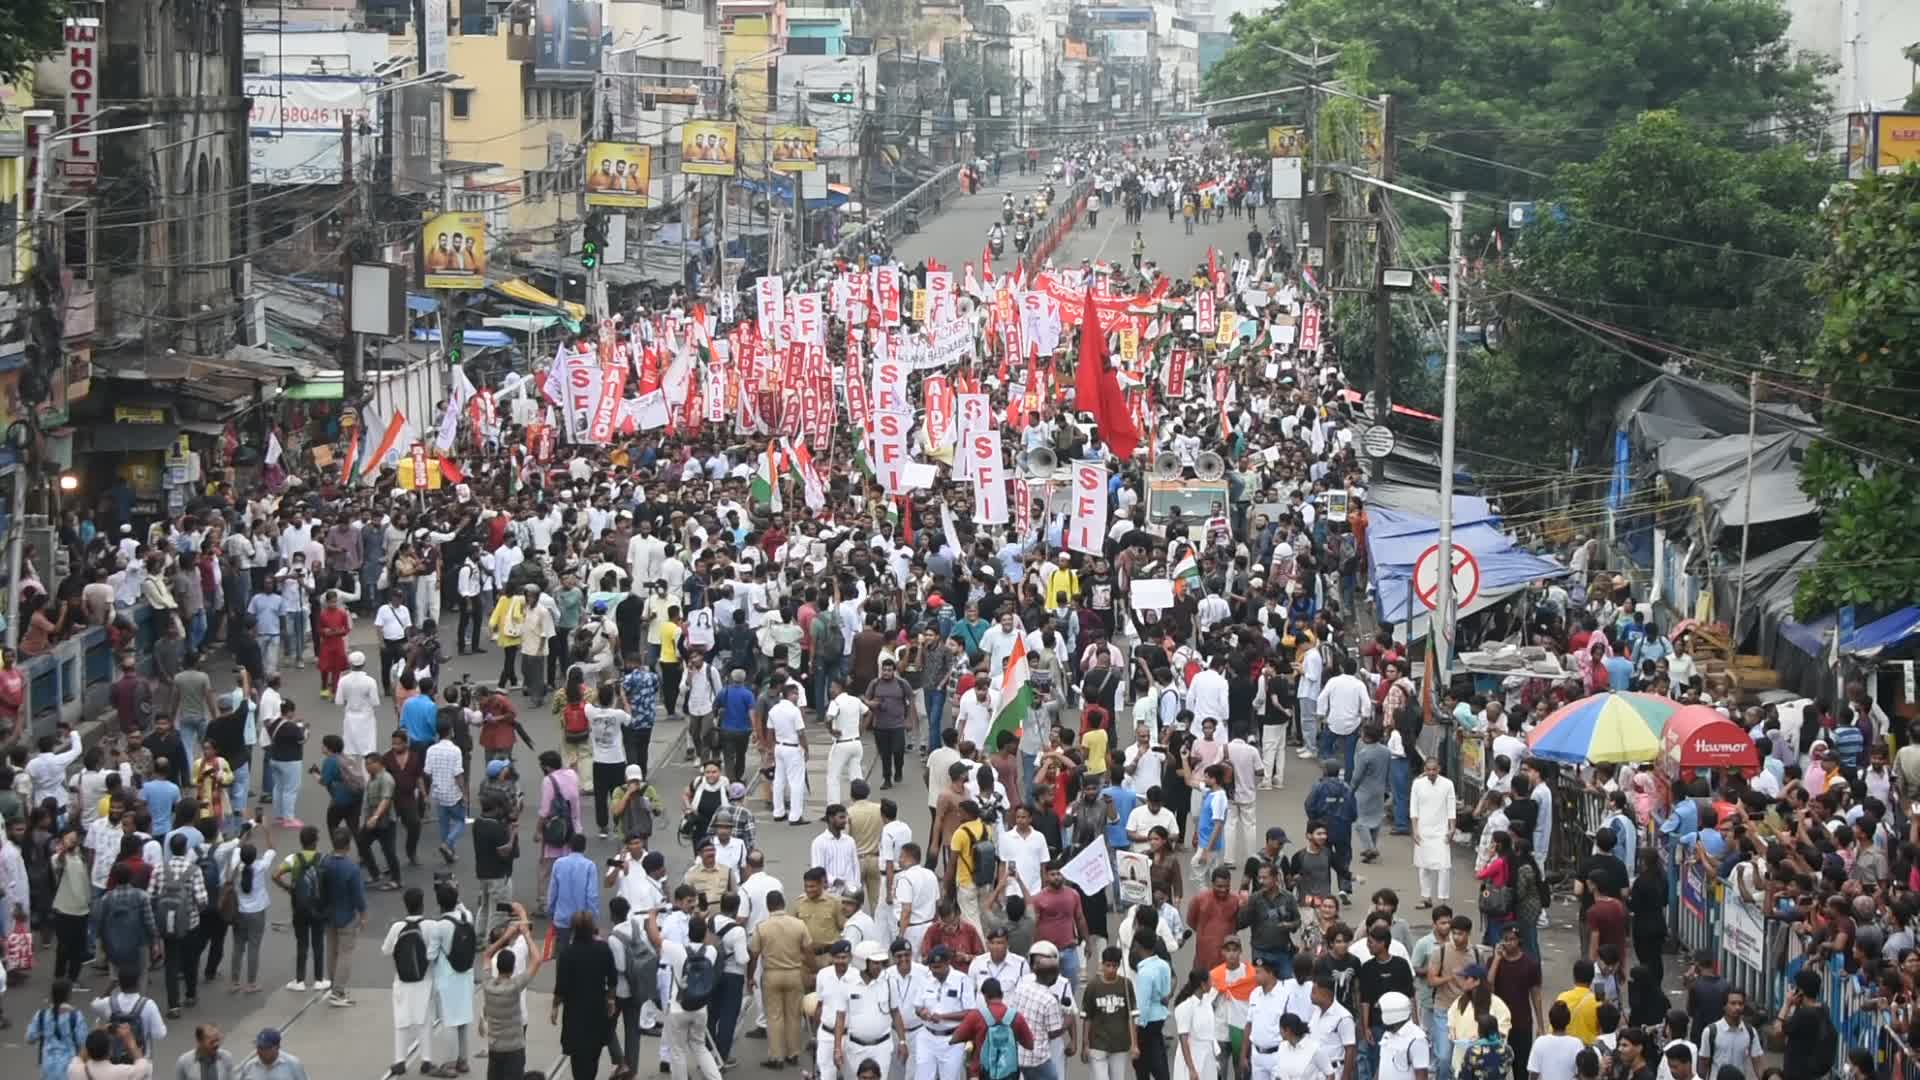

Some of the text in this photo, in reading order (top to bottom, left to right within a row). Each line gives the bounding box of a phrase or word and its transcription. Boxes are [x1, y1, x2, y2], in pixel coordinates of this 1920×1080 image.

[70, 48, 92, 157] HOTEL
[282, 107, 329, 122] 98046
[1200, 292, 1211, 329] AISA
[1303, 308, 1316, 346] AISA
[590, 369, 619, 438] AIDSO
[880, 416, 898, 490] SFI
[975, 436, 993, 520] SFI
[1080, 468, 1099, 548] SFI
